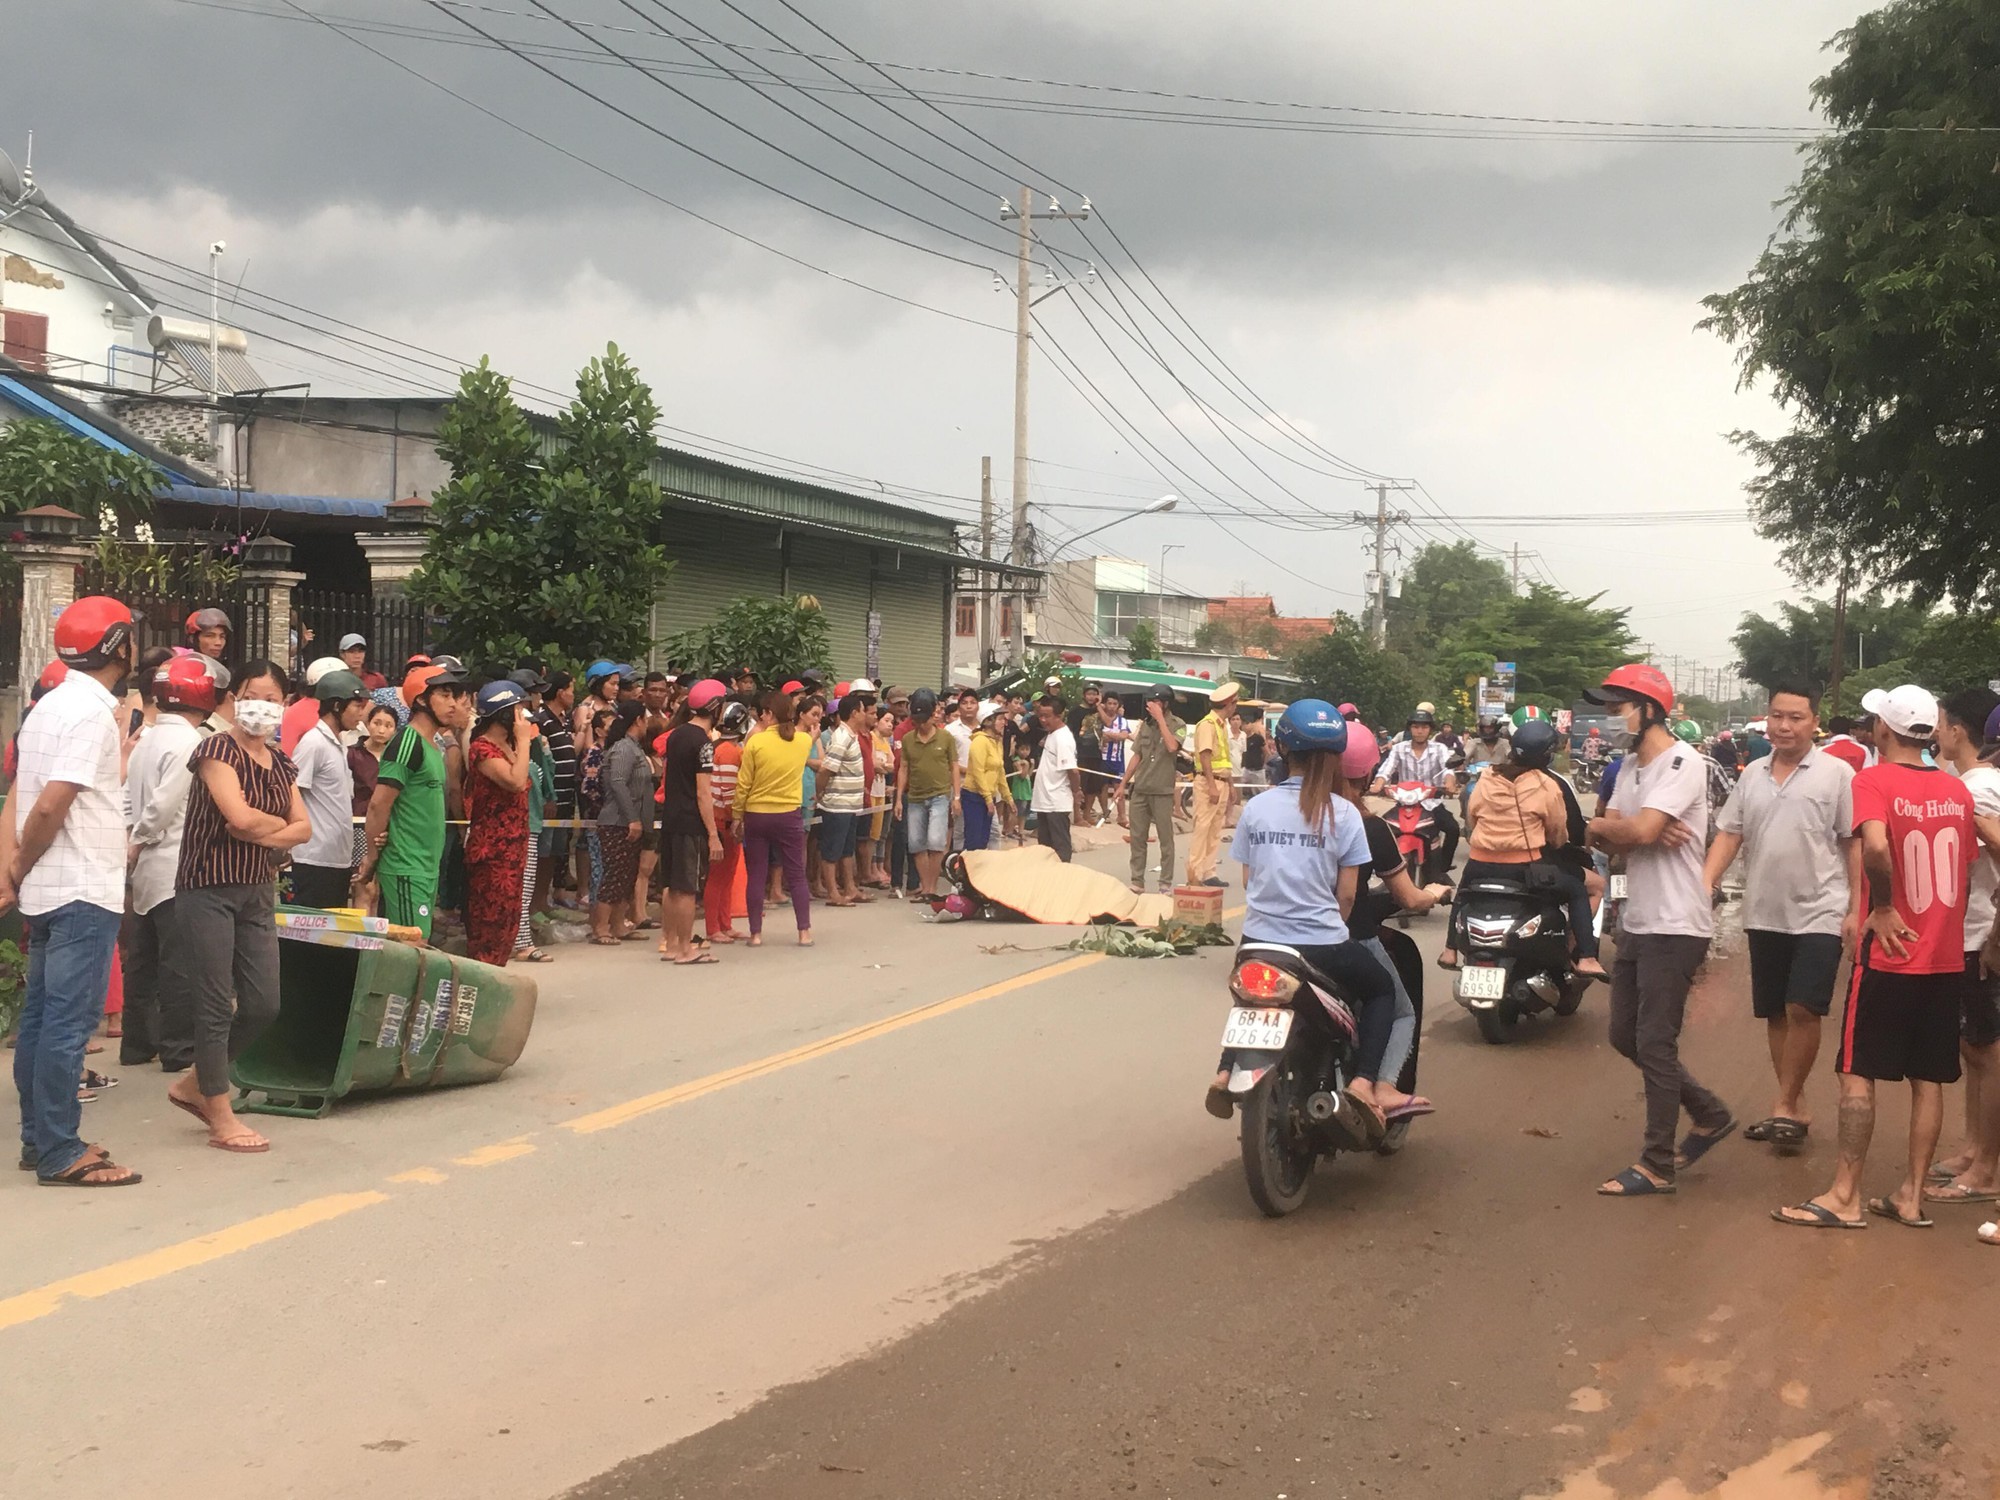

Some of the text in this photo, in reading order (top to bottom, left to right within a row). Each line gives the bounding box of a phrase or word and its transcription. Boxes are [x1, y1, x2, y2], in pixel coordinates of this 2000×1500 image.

[1893, 796, 1924, 823] Công
[1268, 829, 1295, 848] VIỆT
[1903, 826, 1960, 915] 00
[293, 916, 328, 928] POLICE
